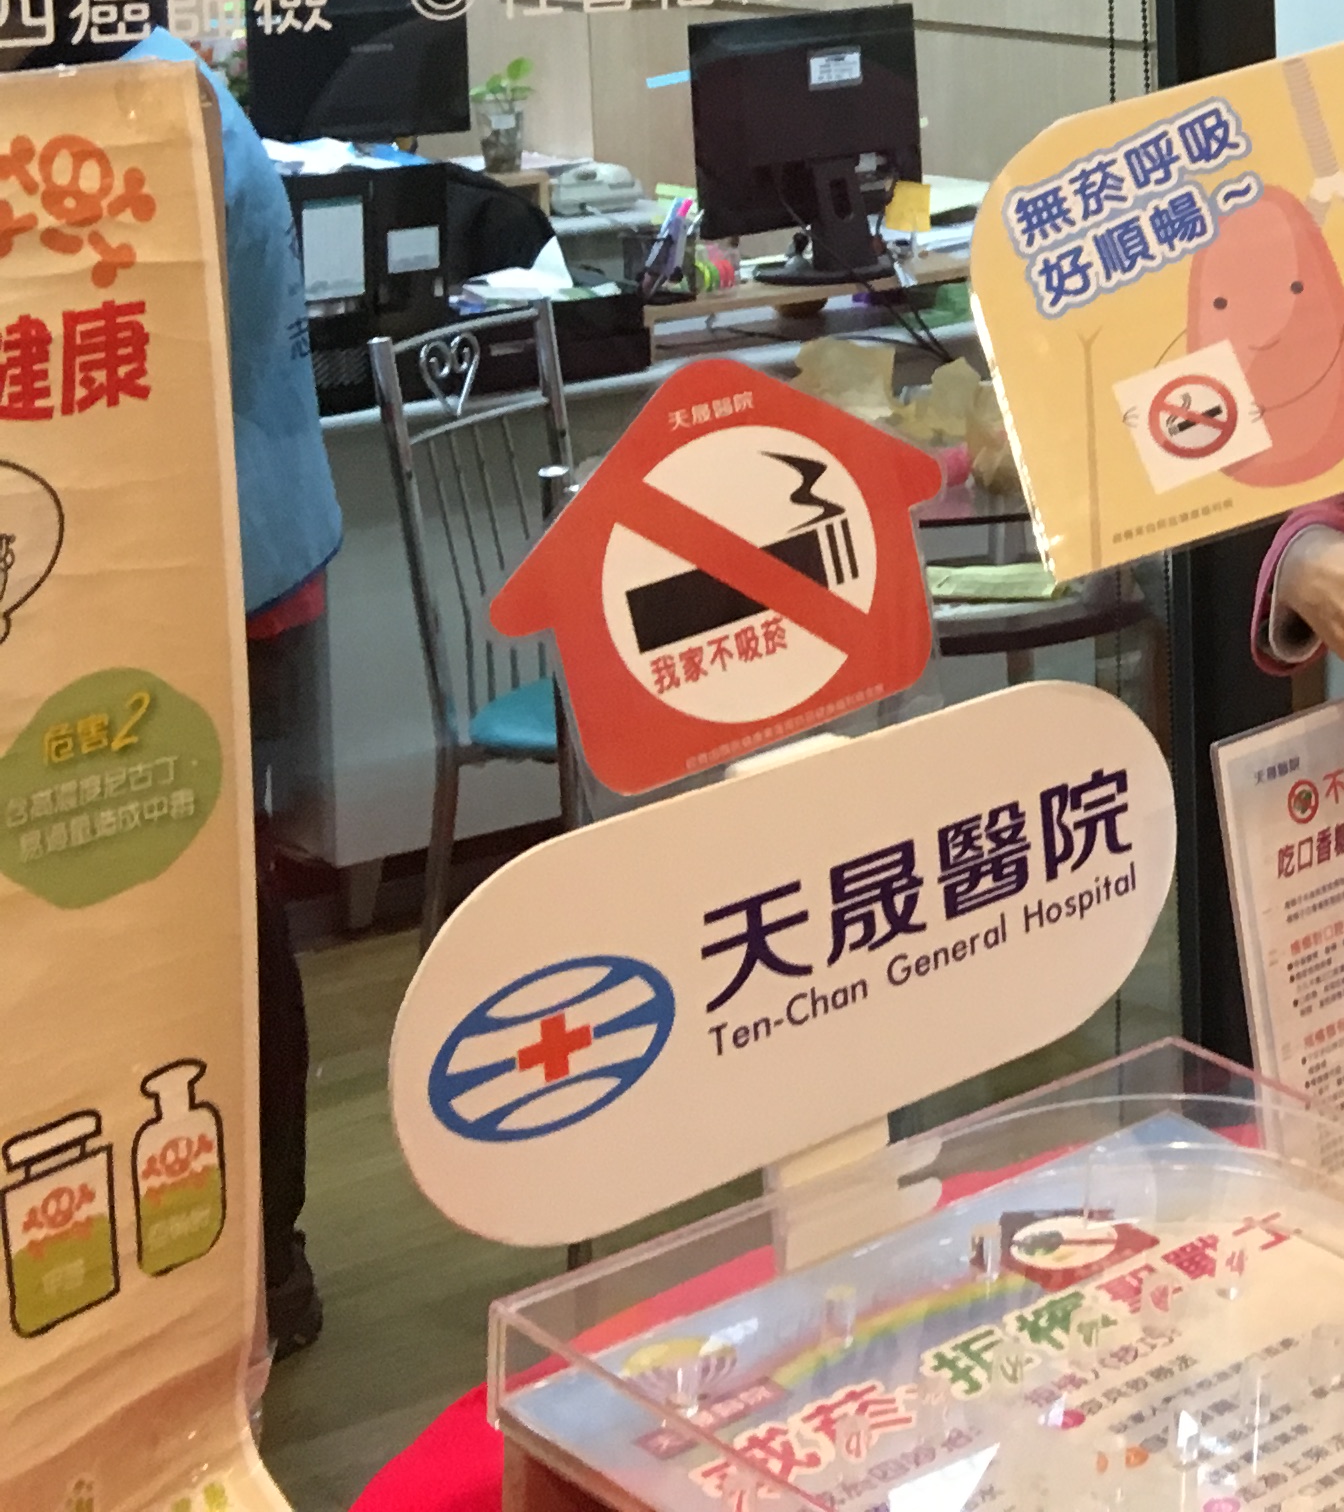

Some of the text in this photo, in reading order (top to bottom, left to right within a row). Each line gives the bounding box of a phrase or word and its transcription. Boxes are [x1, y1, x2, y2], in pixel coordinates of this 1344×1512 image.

[1014, 106, 1242, 249] 無菸呼吸
[668, 390, 755, 431] 天晟醫院
[649, 616, 790, 695] 我家不吸菸
[700, 768, 1133, 1015] 天晟醫院
[708, 861, 1139, 1059] Ten-Chan General Hospital
